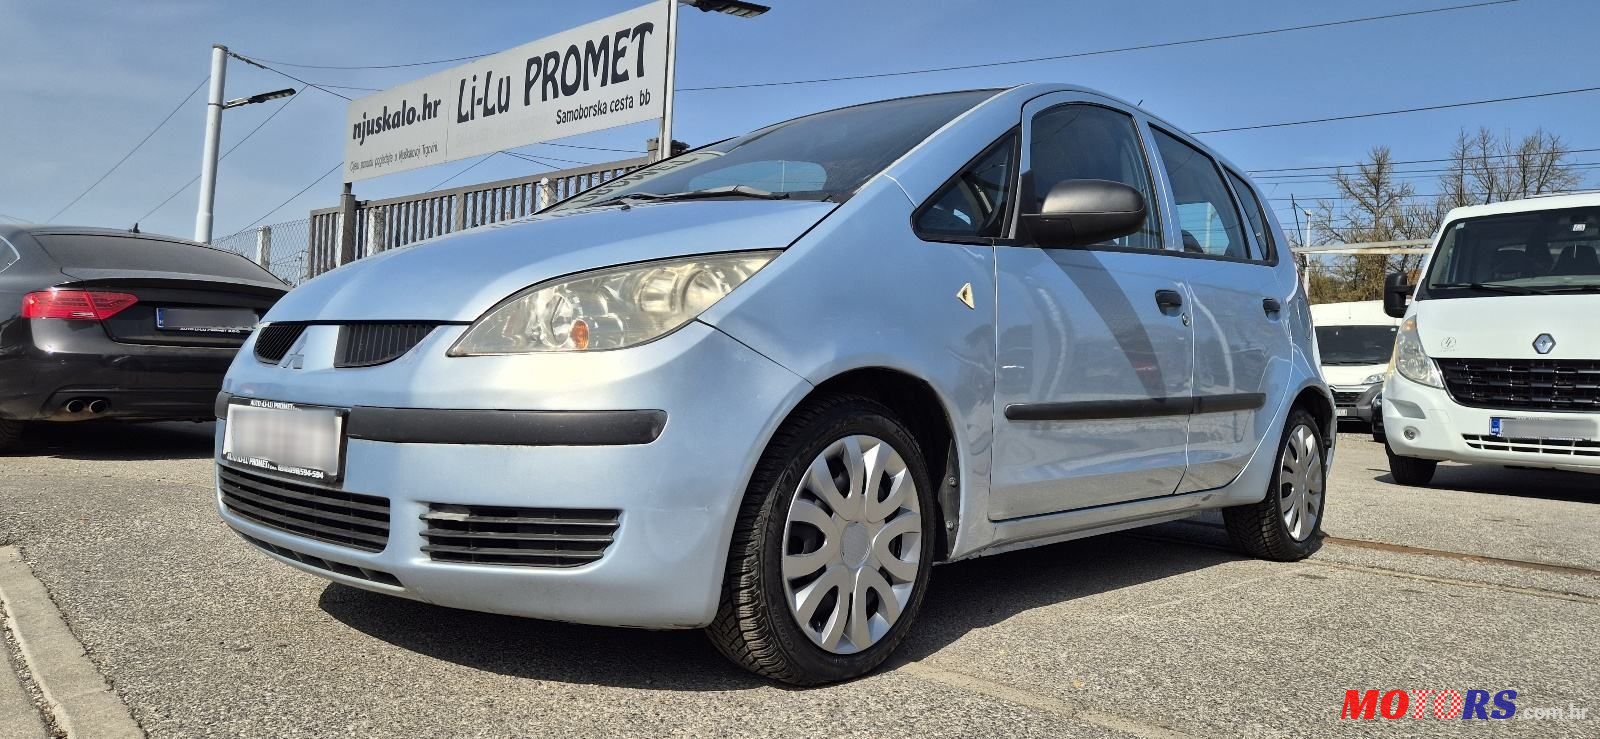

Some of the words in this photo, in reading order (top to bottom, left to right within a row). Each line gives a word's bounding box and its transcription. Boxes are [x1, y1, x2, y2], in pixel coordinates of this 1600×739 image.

[524, 21, 655, 107] PROMET
[353, 93, 441, 146] njuskalo.hr
[556, 99, 607, 125] Samoborska
[609, 94, 634, 113] cesta
[639, 88, 652, 107] bb
